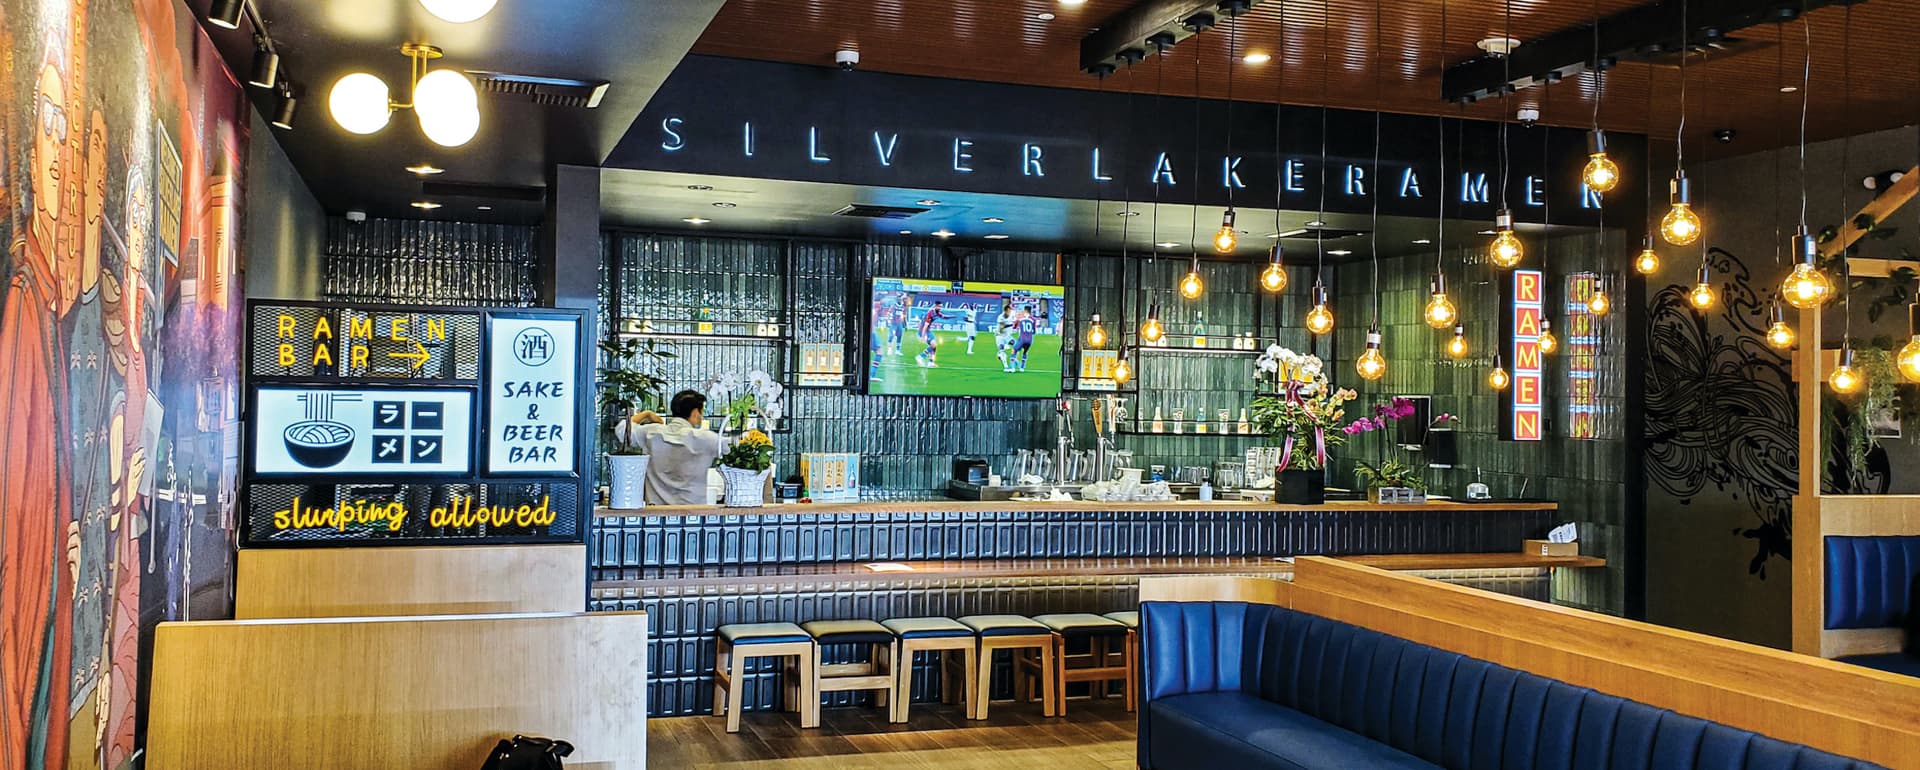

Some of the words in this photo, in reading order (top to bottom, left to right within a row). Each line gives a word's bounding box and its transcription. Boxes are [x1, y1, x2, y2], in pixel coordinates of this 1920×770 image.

[278, 314, 446, 341] RAMEN
[278, 343, 370, 368] BAR
[520, 332, 549, 360] 酒
[1517, 275, 1537, 437] RAMEN
[503, 381, 564, 398] SAKE
[380, 404, 437, 424] ラー
[527, 403, 540, 420] &
[503, 424, 563, 441] BEER
[378, 438, 437, 458] メン
[508, 446, 557, 463] BAR
[274, 497, 408, 531] slurping
[430, 495, 556, 528] allowed
